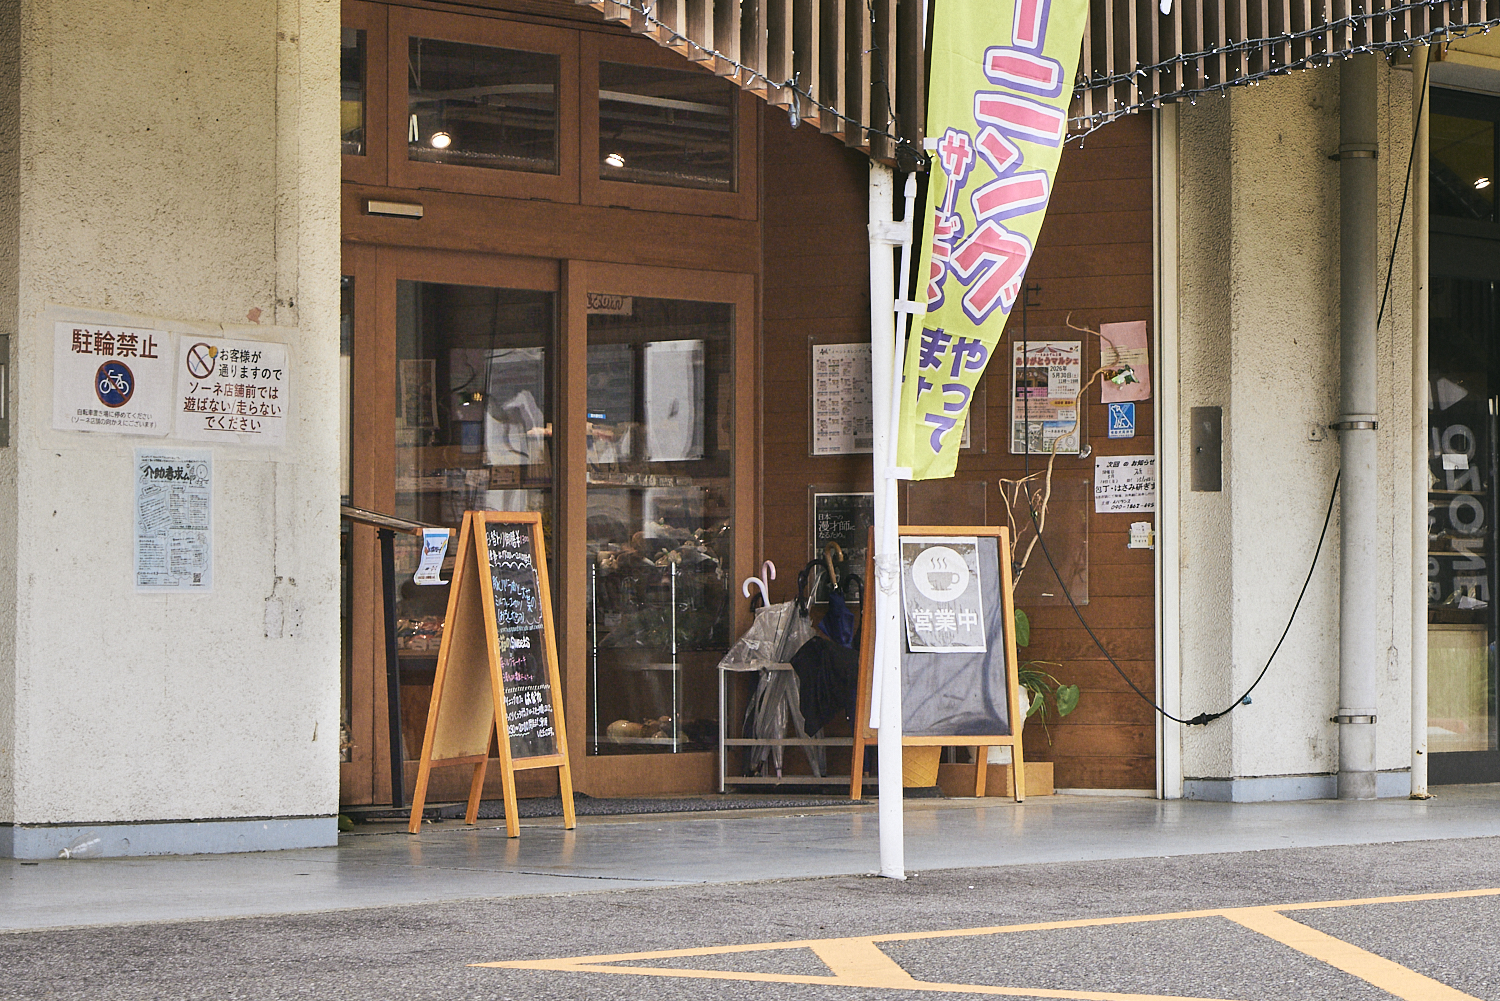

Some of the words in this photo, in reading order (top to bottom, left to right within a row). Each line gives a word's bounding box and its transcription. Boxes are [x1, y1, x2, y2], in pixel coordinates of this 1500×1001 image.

[71, 328, 158, 359] 駐輪禁止
[219, 348, 262, 364] お客様が
[218, 363, 283, 381] 通りますので
[189, 381, 279, 400] ソーネ店舗前では
[924, 337, 988, 455] やって
[205, 415, 262, 431] でください
[1106, 460, 1120, 468] 次回
[911, 608, 978, 632] 営業中
